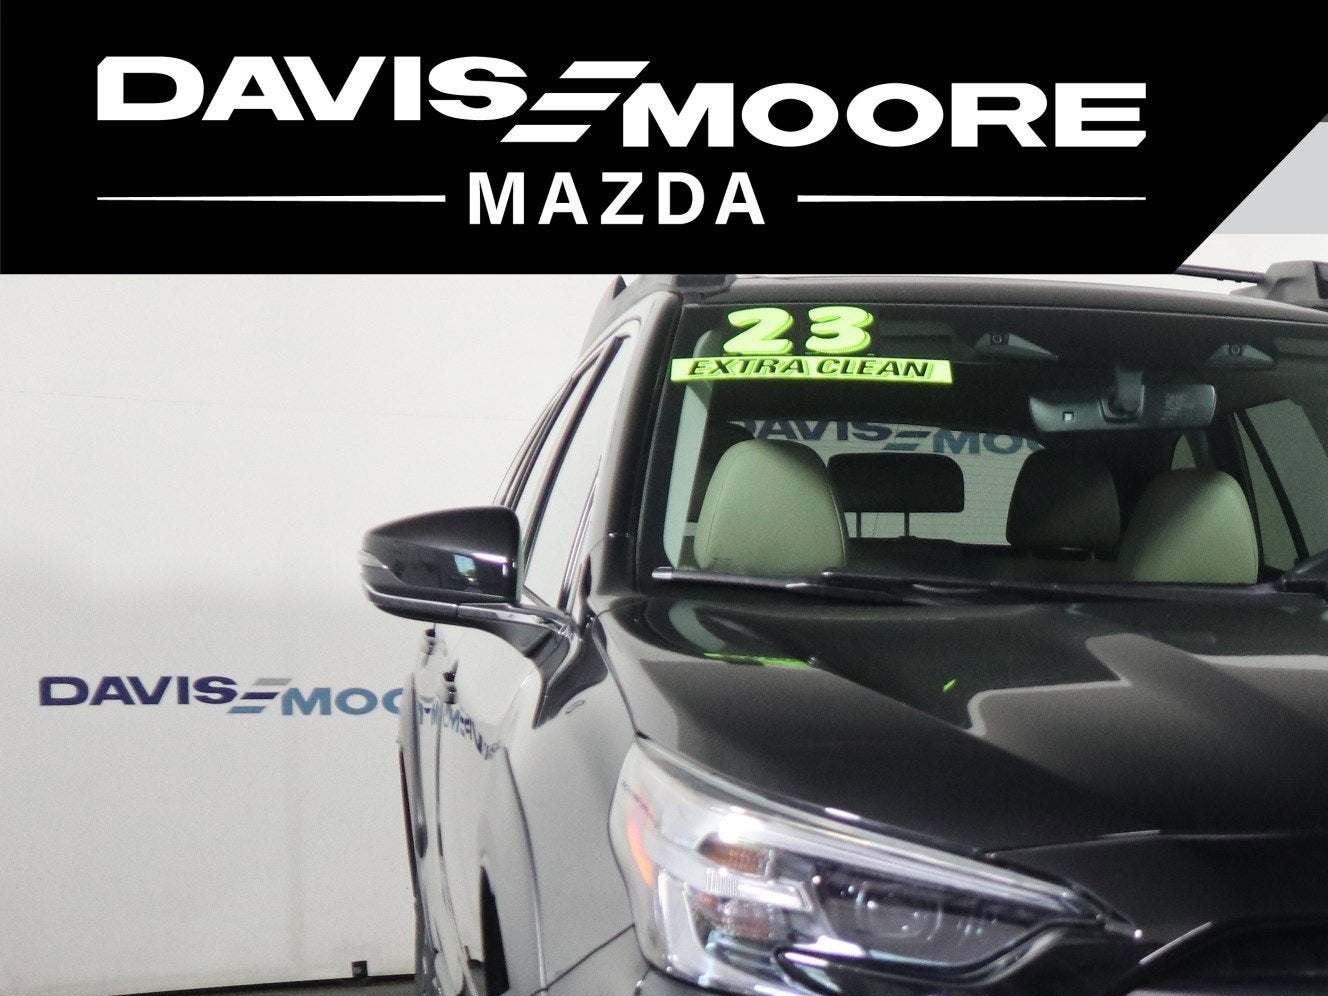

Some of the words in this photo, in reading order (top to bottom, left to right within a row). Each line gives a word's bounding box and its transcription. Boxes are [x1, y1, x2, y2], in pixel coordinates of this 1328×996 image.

[722, 306, 874, 355] 23
[687, 357, 810, 379] EXTRA
[815, 358, 935, 380] CLEAN
[39, 676, 237, 706] DAVIS
